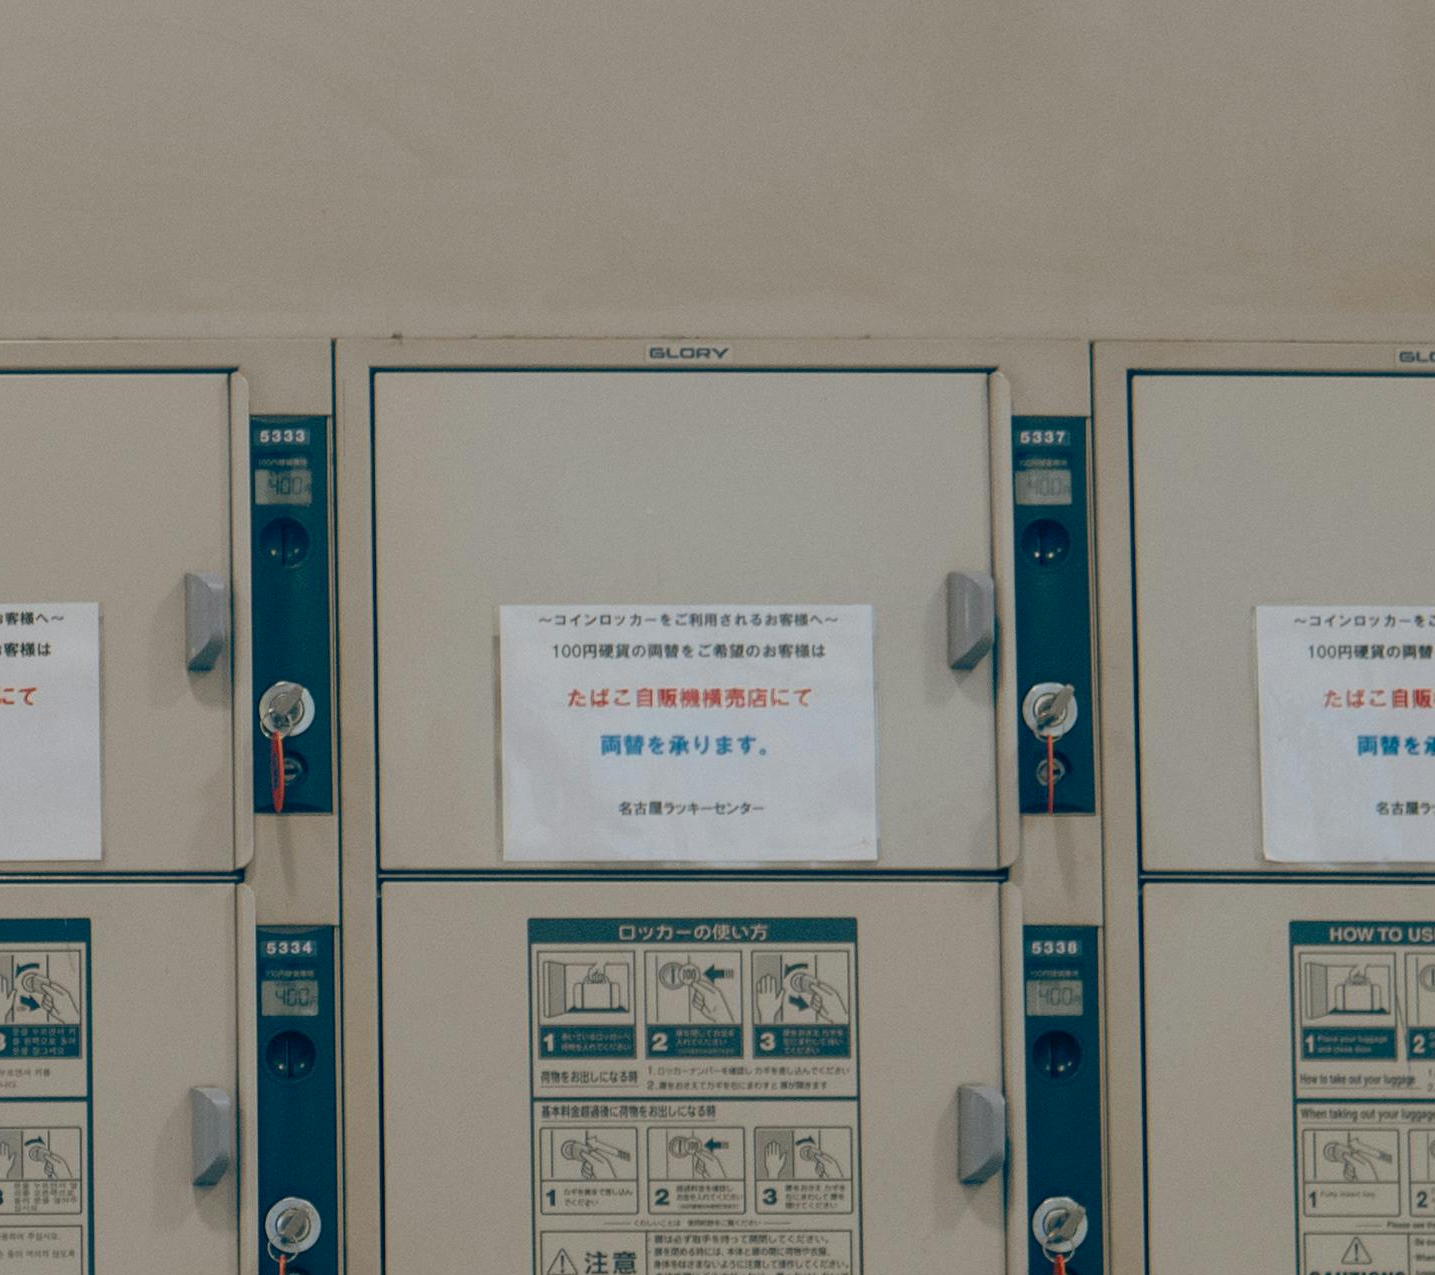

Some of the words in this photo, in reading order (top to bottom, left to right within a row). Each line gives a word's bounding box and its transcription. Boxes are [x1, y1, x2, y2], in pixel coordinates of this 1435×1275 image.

[649, 347, 730, 359] GLORY
[259, 430, 305, 443] 5333
[1020, 431, 1065, 444] 5337
[568, 687, 812, 709] たばこ自販機横売店にて
[618, 923, 768, 942] ロッカーの使い方
[1329, 927, 1374, 943] HOW
[1377, 927, 1402, 943] TO
[266, 942, 312, 954] 5334
[1032, 942, 1077, 955] 5338
[584, 1250, 638, 1275] 注意
